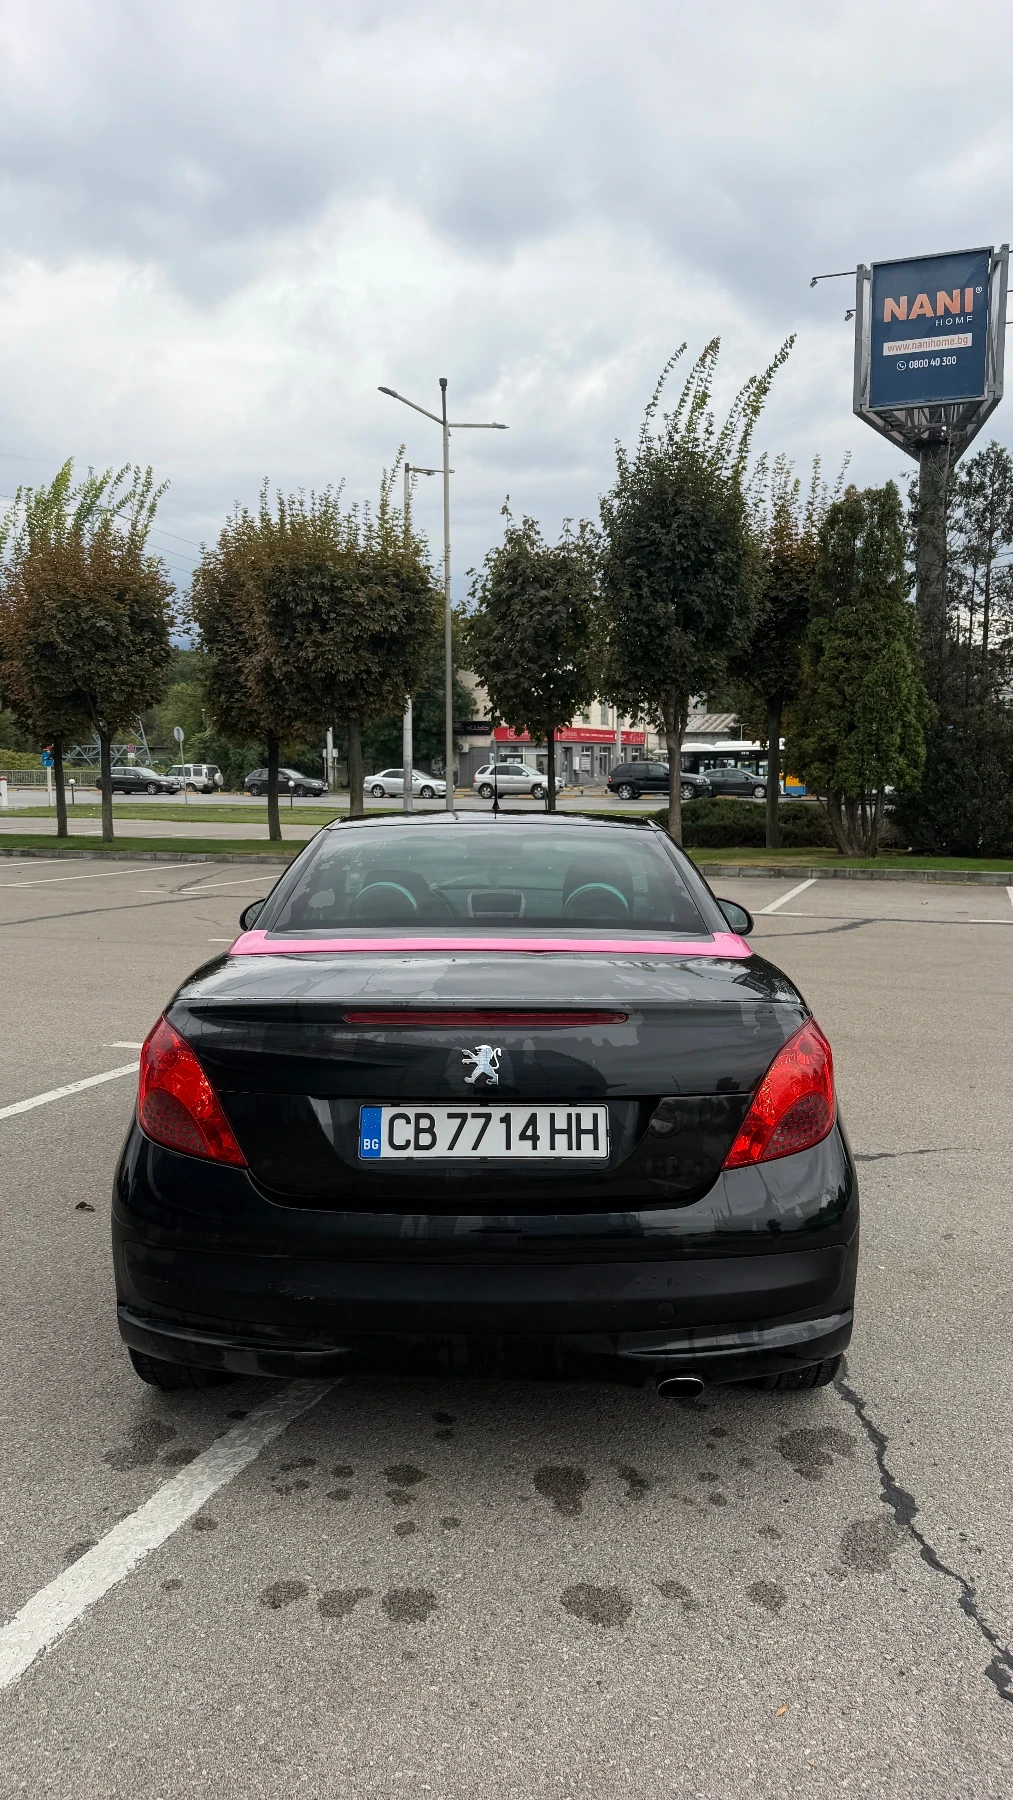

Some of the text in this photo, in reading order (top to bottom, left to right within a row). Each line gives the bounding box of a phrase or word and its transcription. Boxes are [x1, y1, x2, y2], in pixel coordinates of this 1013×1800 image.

[883, 287, 974, 322] NANI
[887, 335, 969, 353] www.nanihome.bg
[908, 356, 957, 369] 0800 40 300
[388, 1112, 600, 1151] CB 7714 HH
[363, 1138, 379, 1150] BG
